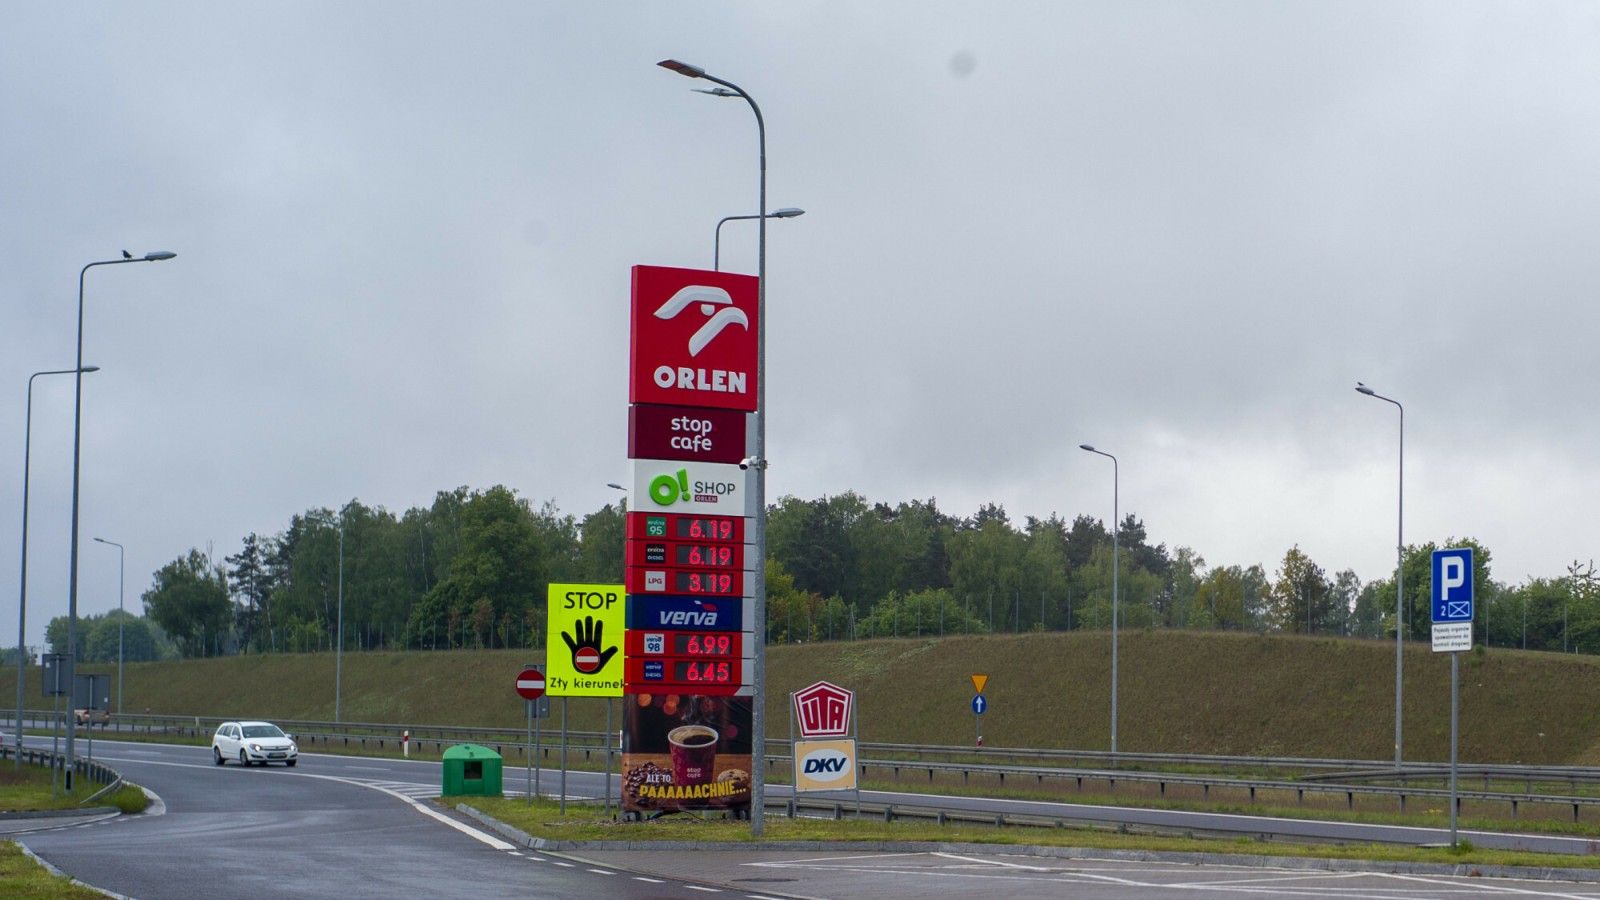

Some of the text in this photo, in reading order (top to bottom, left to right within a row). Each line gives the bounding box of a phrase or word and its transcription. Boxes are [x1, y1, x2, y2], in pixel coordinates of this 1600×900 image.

[653, 365, 747, 393] ORLEN
[671, 416, 712, 436] stop
[671, 435, 712, 452] cafe
[694, 481, 736, 495] SHOP
[650, 526, 663, 535] 95
[689, 519, 732, 539] 6.19
[688, 546, 731, 566] 6.19
[648, 577, 662, 585] LPG
[689, 573, 731, 593] 3.19
[1441, 556, 1465, 601] P
[564, 592, 618, 609] STOP
[660, 610, 718, 626] verva
[1440, 605, 1446, 616] 2
[648, 643, 661, 651] 98
[687, 635, 730, 655] 6.99
[687, 662, 729, 681] 6.45
[550, 677, 569, 691] Zły
[801, 688, 847, 731] UTA
[804, 757, 848, 773] DKV
[646, 774, 671, 783] ALE TO
